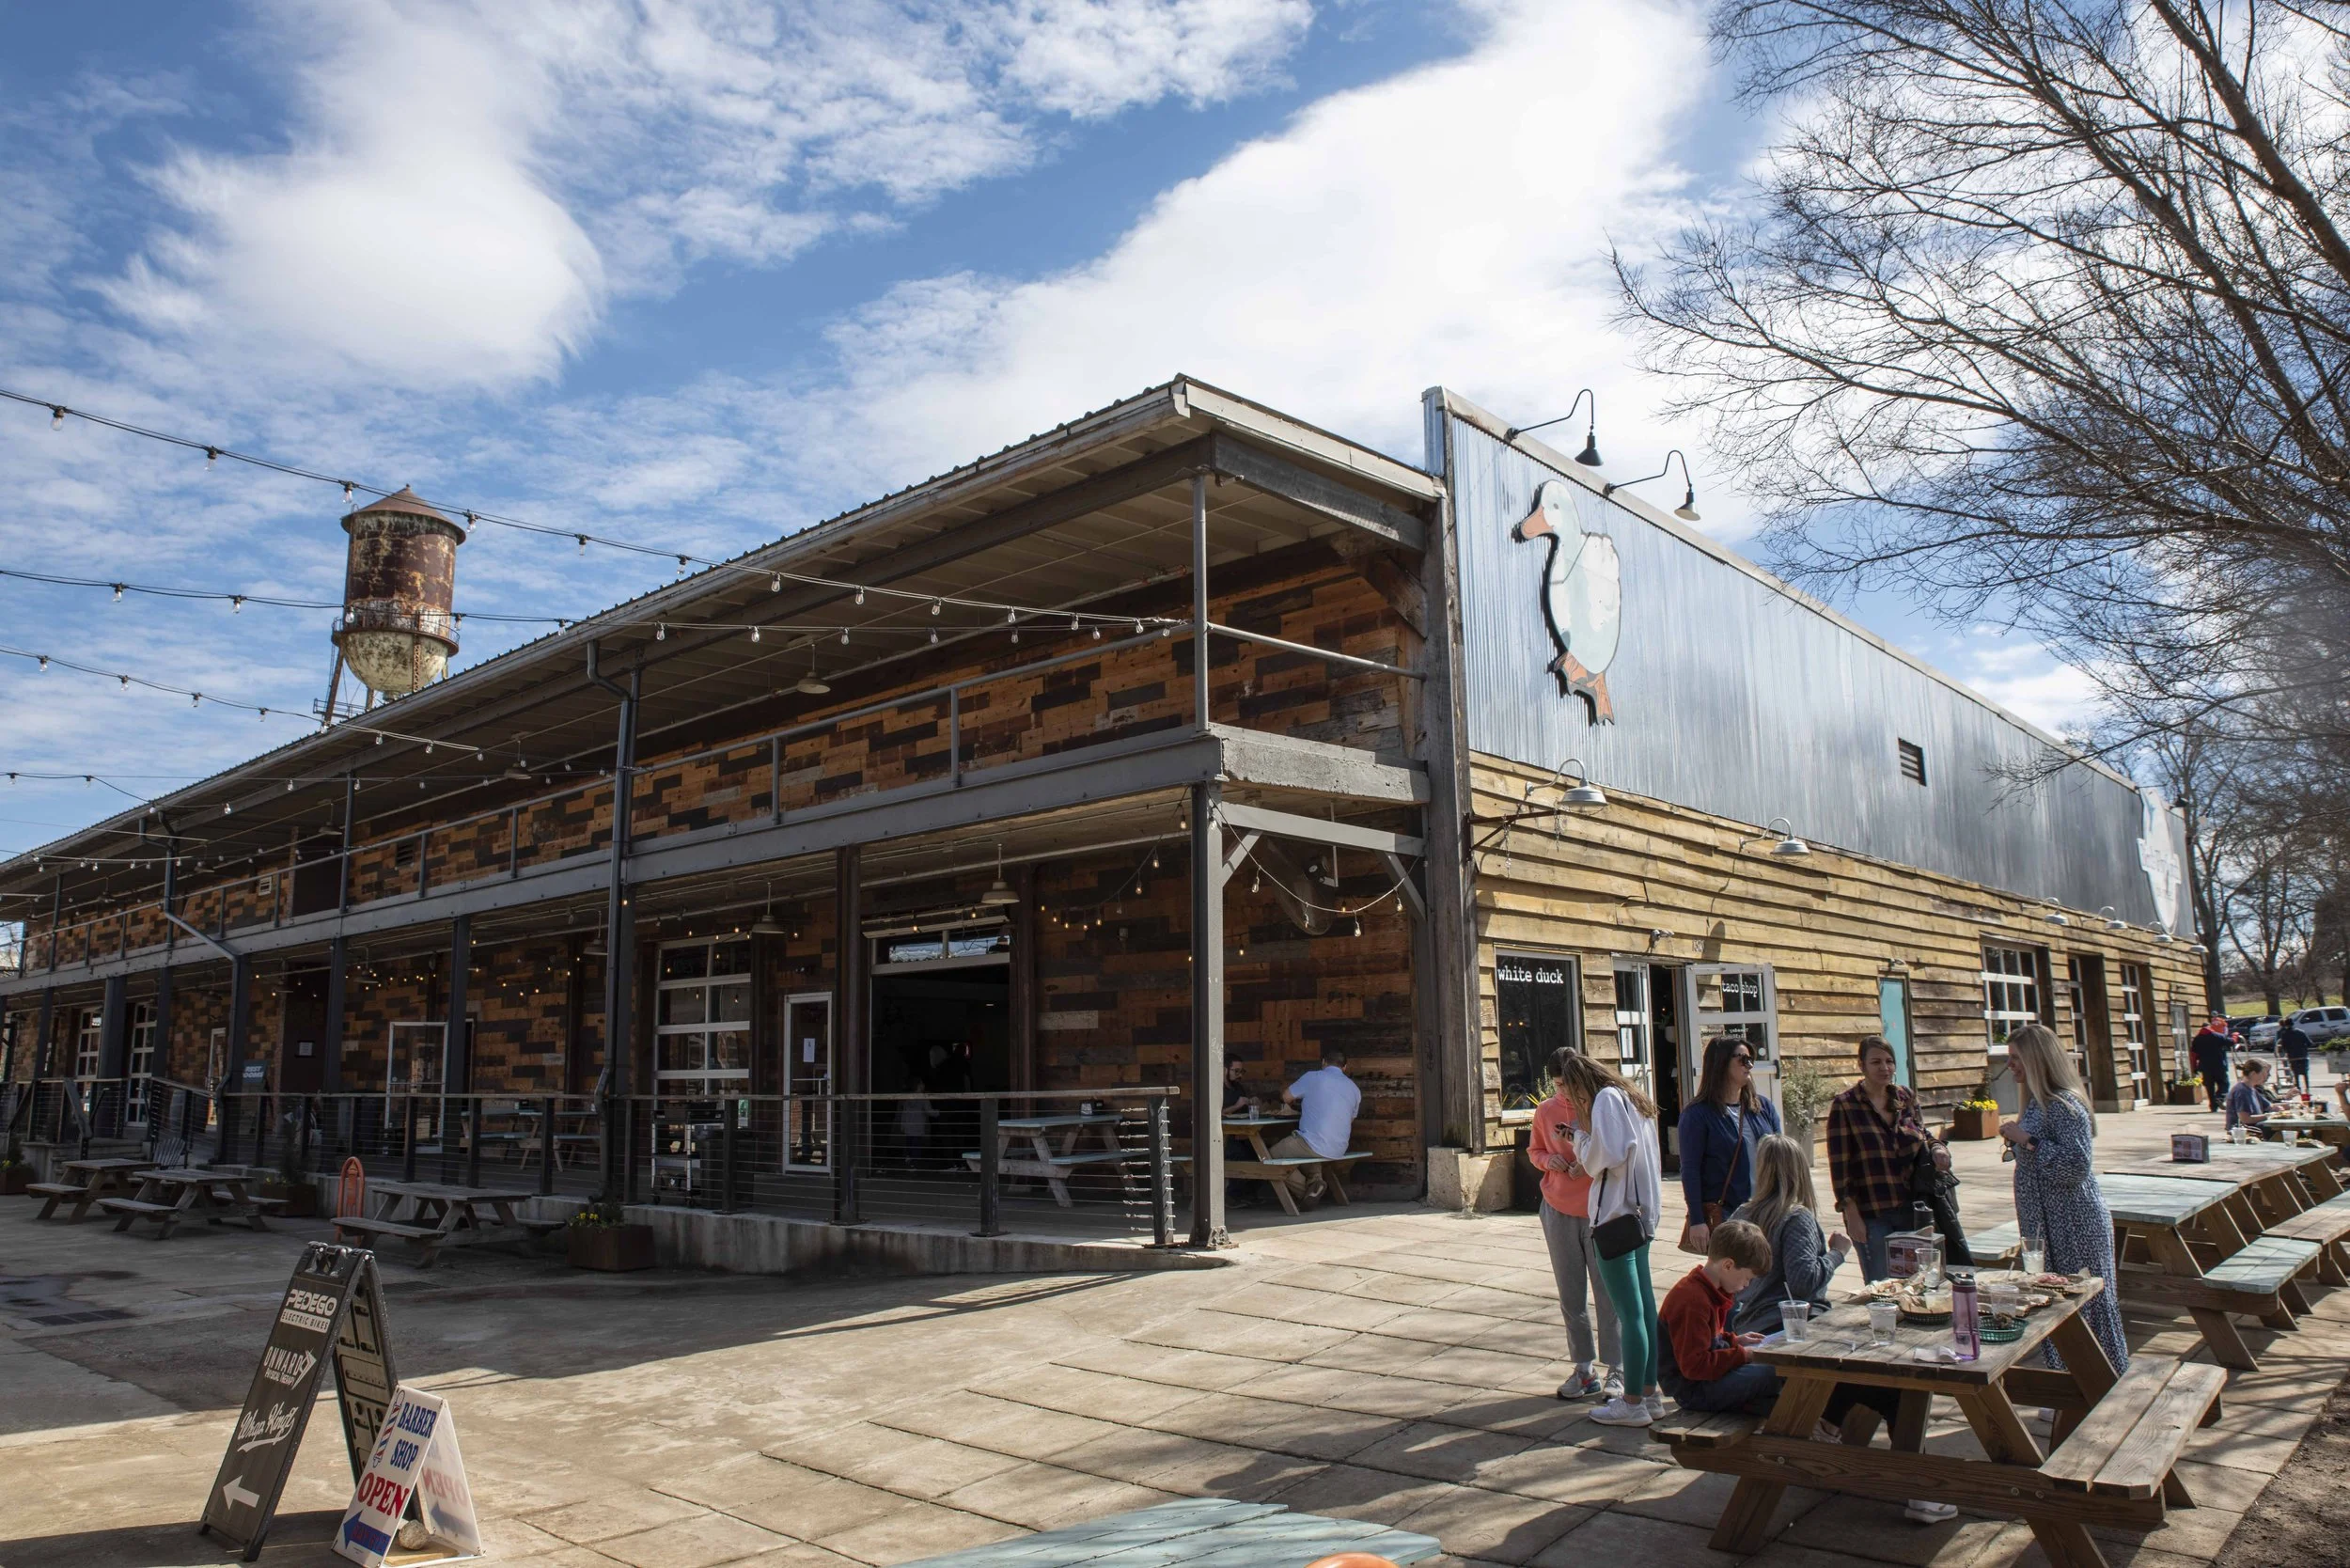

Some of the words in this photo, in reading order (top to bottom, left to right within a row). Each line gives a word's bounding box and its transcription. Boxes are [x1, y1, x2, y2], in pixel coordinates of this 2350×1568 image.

[1497, 965, 1532, 983] white
[1535, 968, 1564, 984] duck
[1721, 980, 1739, 994] taco
[1741, 981, 1758, 997] shop
[286, 1289, 337, 1316] PEDEGO
[281, 1311, 309, 1326] ELECTRIC
[309, 1318, 329, 1331] BIKES
[264, 1346, 306, 1376] ONWARD
[398, 1402, 437, 1439] BARBER
[390, 1439, 419, 1472] SHOP
[357, 1472, 411, 1520] OPEN
